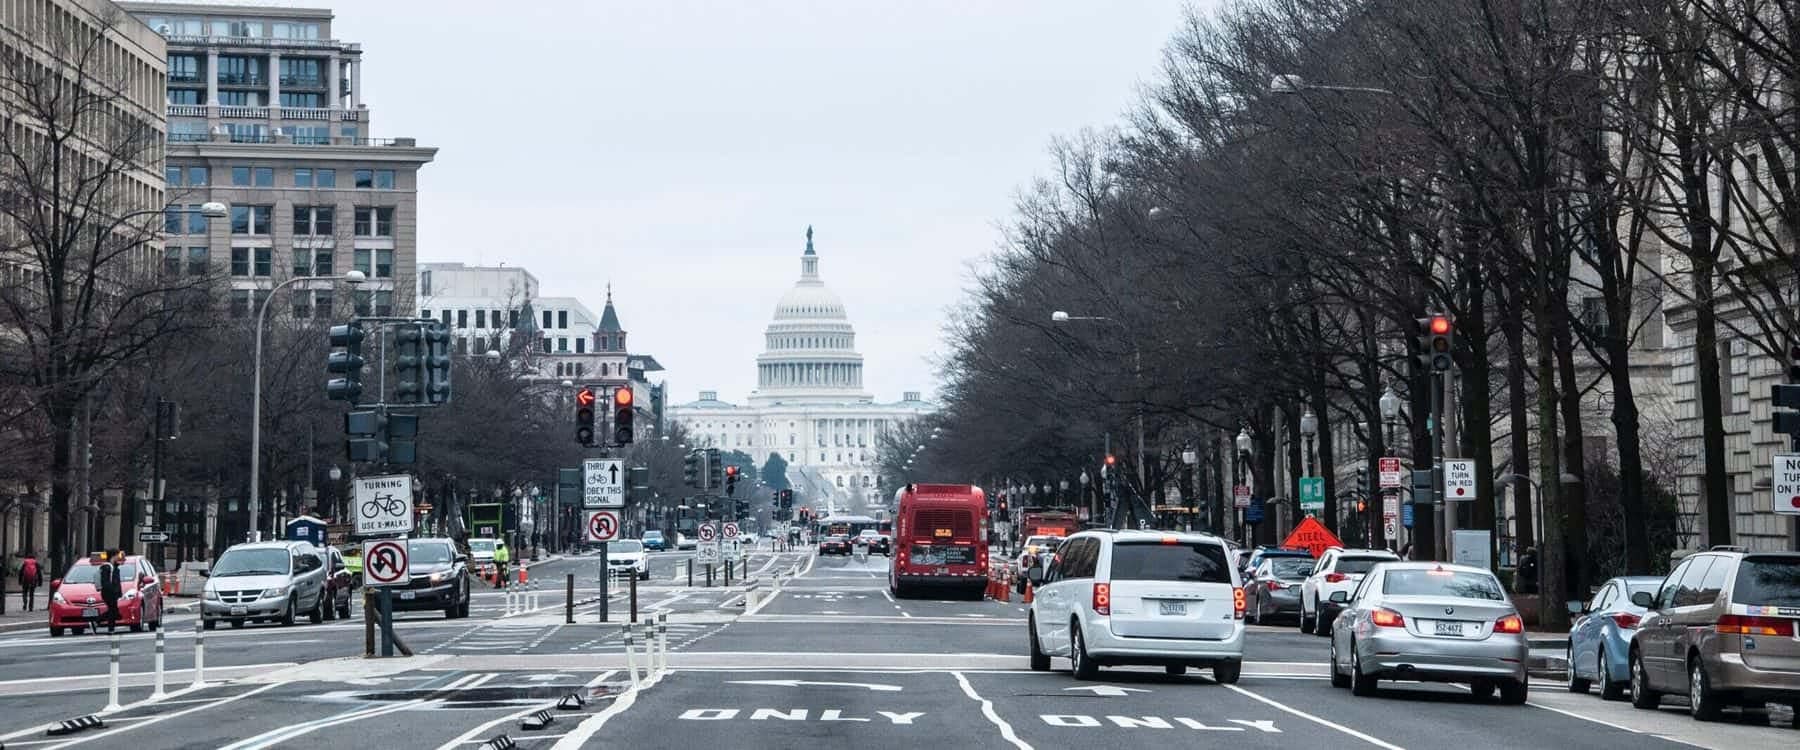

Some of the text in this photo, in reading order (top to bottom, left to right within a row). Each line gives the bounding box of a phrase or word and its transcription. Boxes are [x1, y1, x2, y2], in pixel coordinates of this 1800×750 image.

[587, 462, 605, 470] THRU
[1452, 463, 1466, 471] NO
[364, 480, 402, 489] TURNING
[1777, 484, 1791, 494] ON
[586, 486, 622, 495] OBEY THIS
[586, 496, 610, 504] SIGNAL
[361, 520, 408, 530] USE X-WALKS
[1297, 531, 1326, 542] STEEL
[678, 708, 927, 725] ONLY
[1039, 714, 1284, 733] ONLY
